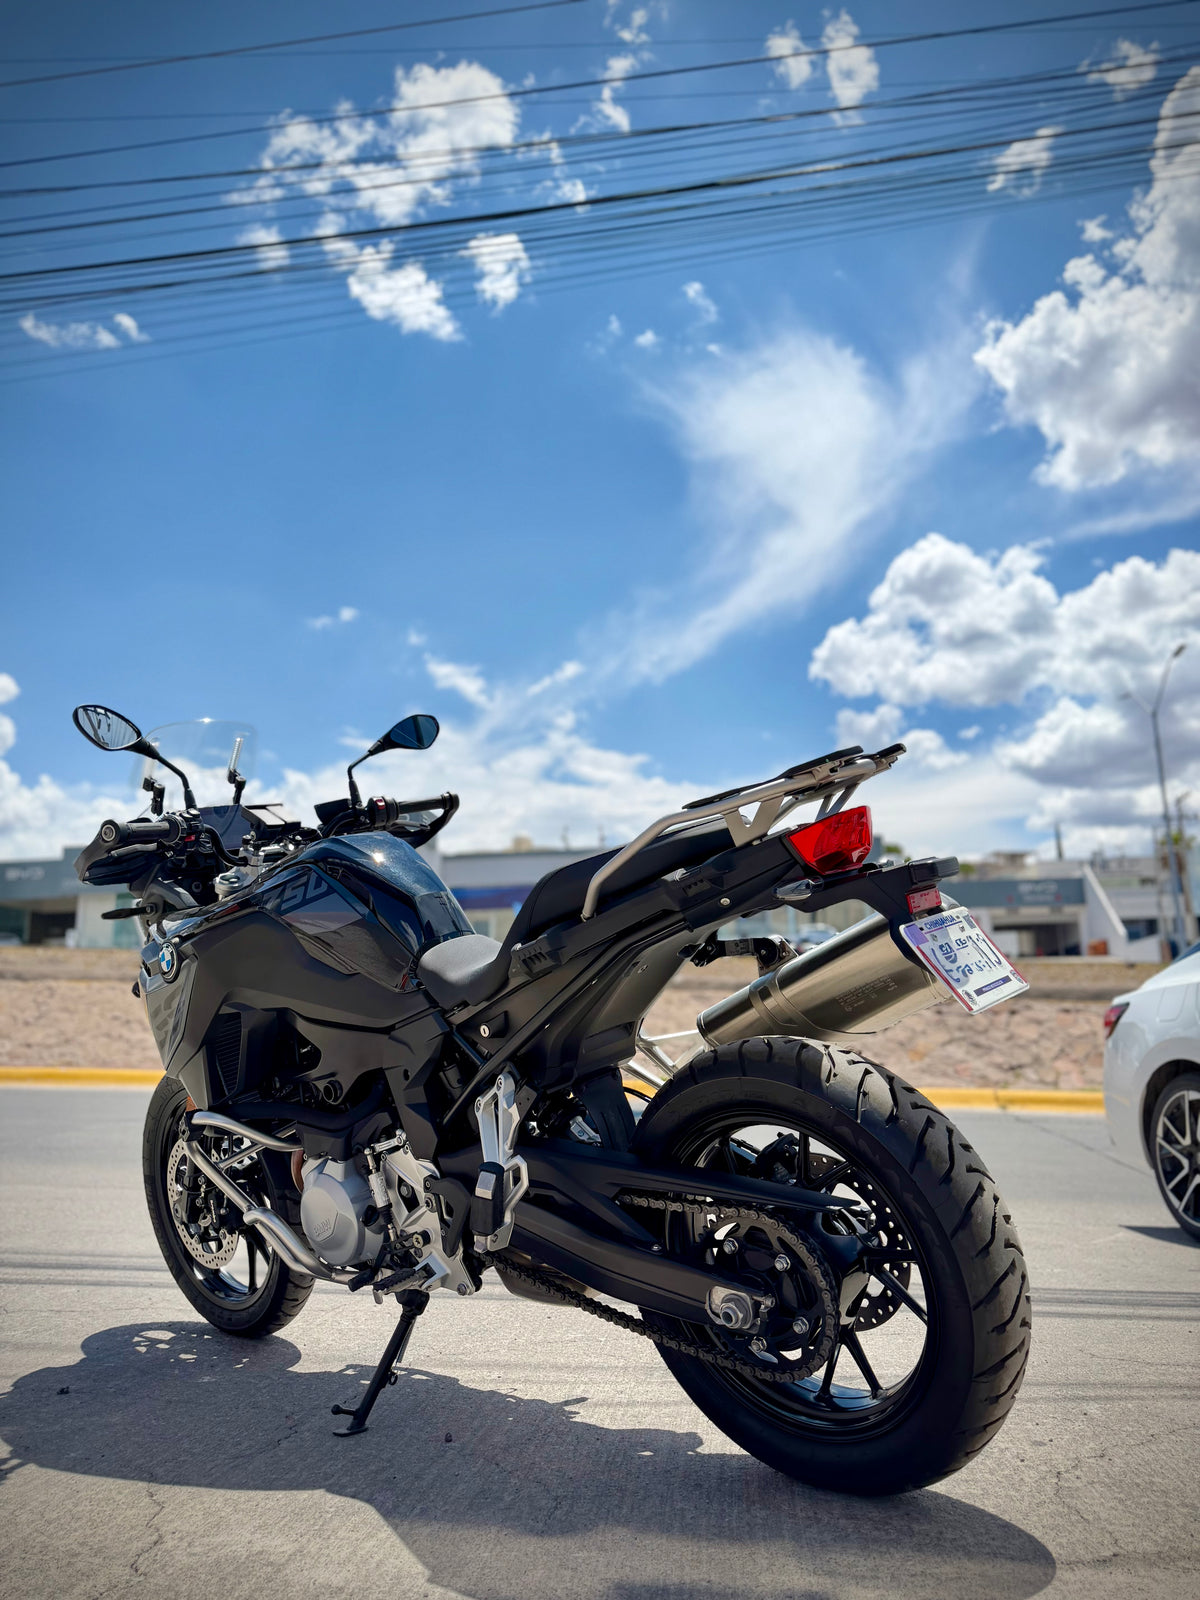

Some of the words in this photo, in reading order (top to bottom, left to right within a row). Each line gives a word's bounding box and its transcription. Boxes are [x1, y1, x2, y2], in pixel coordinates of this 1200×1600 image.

[261, 870, 328, 911] 750
[924, 915, 956, 930] CHIHUAHUA
[313, 1217, 331, 1235] BMW
